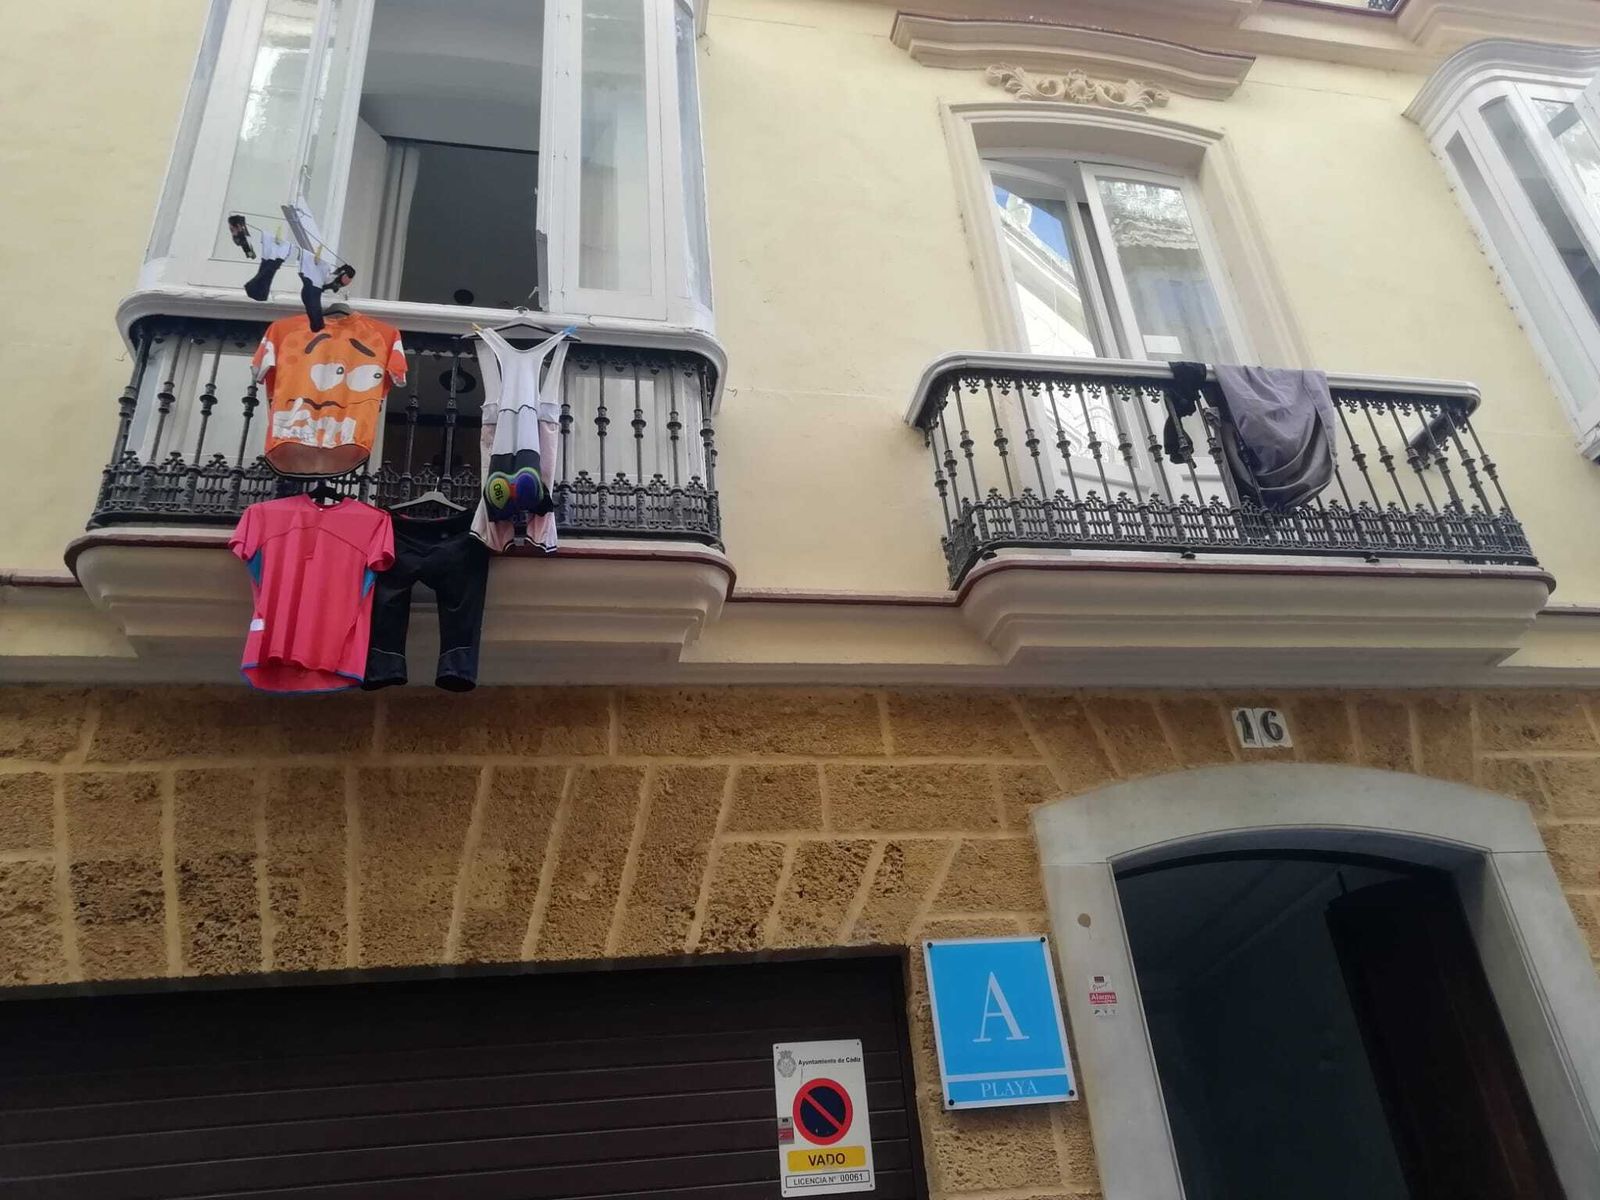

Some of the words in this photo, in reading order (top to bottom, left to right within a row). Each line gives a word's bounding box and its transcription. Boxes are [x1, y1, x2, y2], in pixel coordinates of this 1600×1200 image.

[1236, 710, 1284, 743] 16
[972, 971, 1030, 1042] A
[798, 1058, 836, 1066] Ayuntamiento
[981, 1079, 1038, 1098] PLAYA
[808, 1153, 846, 1167] VADO
[793, 1176, 828, 1186] LICENCIA
[840, 1173, 864, 1182] 00061
